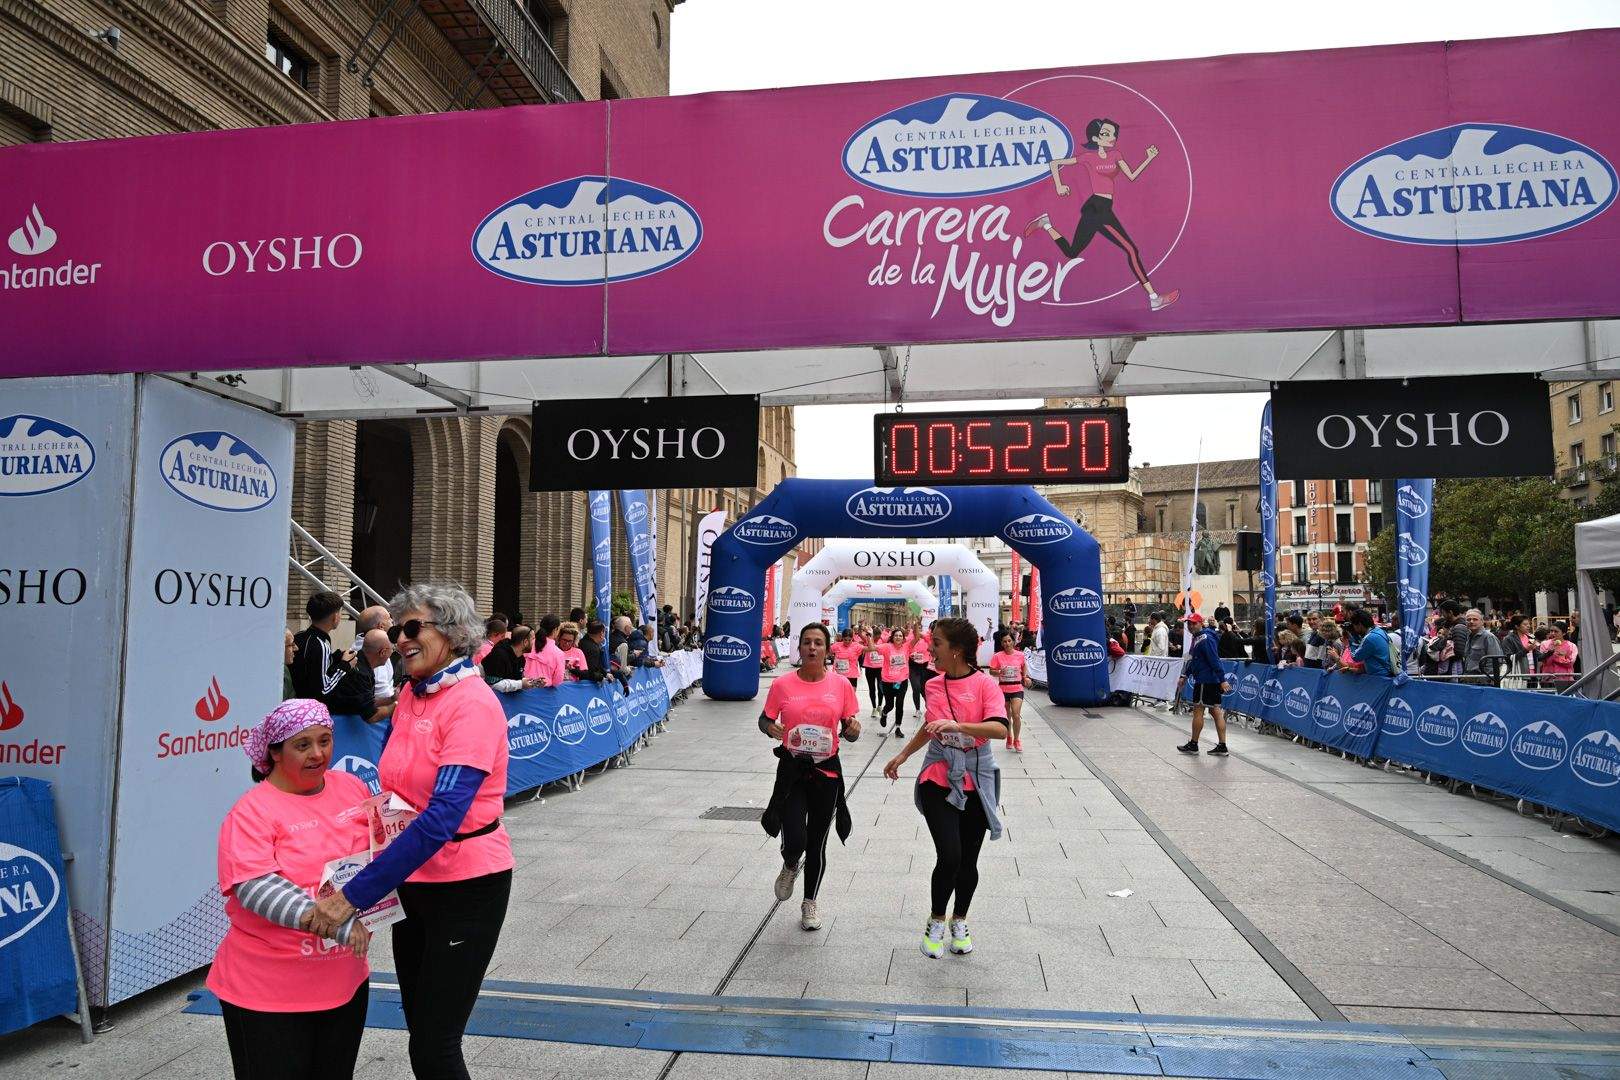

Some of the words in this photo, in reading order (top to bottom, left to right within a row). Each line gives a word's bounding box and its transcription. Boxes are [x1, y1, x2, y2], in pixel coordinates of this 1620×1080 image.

[894, 130, 966, 143] CENTRAL
[973, 124, 1048, 138] LECHERA
[859, 136, 1055, 175] ASTURIANA
[1395, 165, 1483, 181] CENTRAL
[1493, 159, 1585, 175] LECHERA
[1353, 174, 1598, 219] ASTURIANA
[524, 213, 596, 229] CENTRAL
[602, 208, 676, 224] LECHERA
[822, 195, 1011, 248] Carrera
[489, 221, 685, 262] ASTURIANA
[202, 233, 363, 276] OYSHO
[868, 249, 902, 287] de
[911, 247, 936, 286] la
[930, 236, 1085, 328] Mujer
[1317, 410, 1510, 450] OYSHO
[31, 441, 80, 451] LECHERA
[567, 427, 726, 461] OYSHO
[0, 453, 83, 476] URIANA
[169, 450, 270, 499] ASTURIANA
[189, 451, 229, 468] CENTRAL
[231, 459, 268, 477] LECHERA
[854, 497, 945, 517] ASTURIANA
[737, 527, 793, 538] ASTURIANA
[1010, 526, 1068, 538] ASTURIANA
[854, 550, 936, 567] OYSHO
[154, 569, 272, 609] OYSHO
[1053, 600, 1100, 610] ASTURIANA
[1055, 651, 1103, 661] ASTURIANA
[1128, 659, 1170, 680] OYSHO
[1384, 714, 1410, 728] TURIANA
[1418, 717, 1455, 738] ASTURIANA
[158, 724, 252, 759] Santande
[1464, 725, 1504, 749] ASTURIANA
[1514, 734, 1562, 761] ASTURIANA
[386, 821, 406, 835] 016
